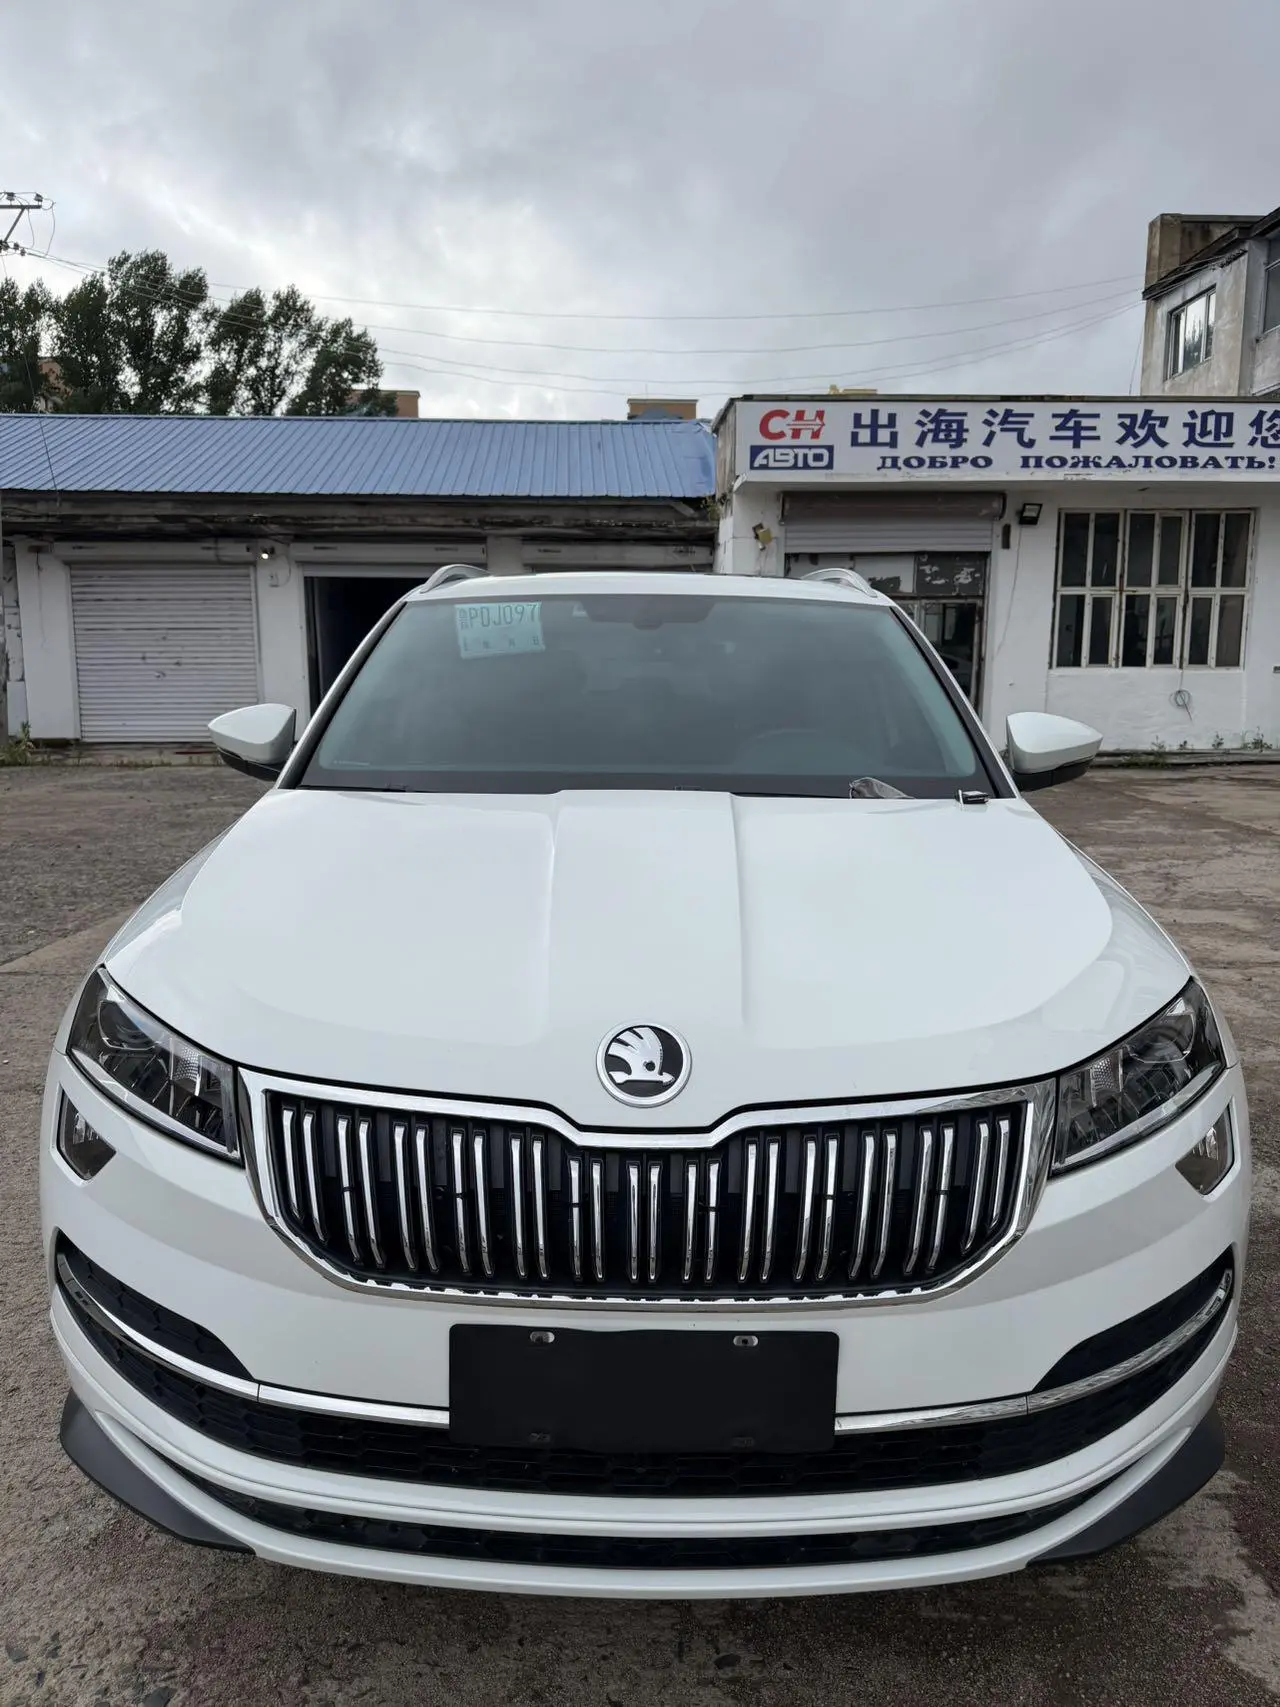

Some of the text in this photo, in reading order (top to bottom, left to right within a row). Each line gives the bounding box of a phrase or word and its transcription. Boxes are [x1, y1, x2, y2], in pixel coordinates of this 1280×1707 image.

[850, 408, 1280, 449] 出海汽车欢迎您
[876, 454, 1276, 471] ДОБРО ПОЖАЛОВАТЬ!
